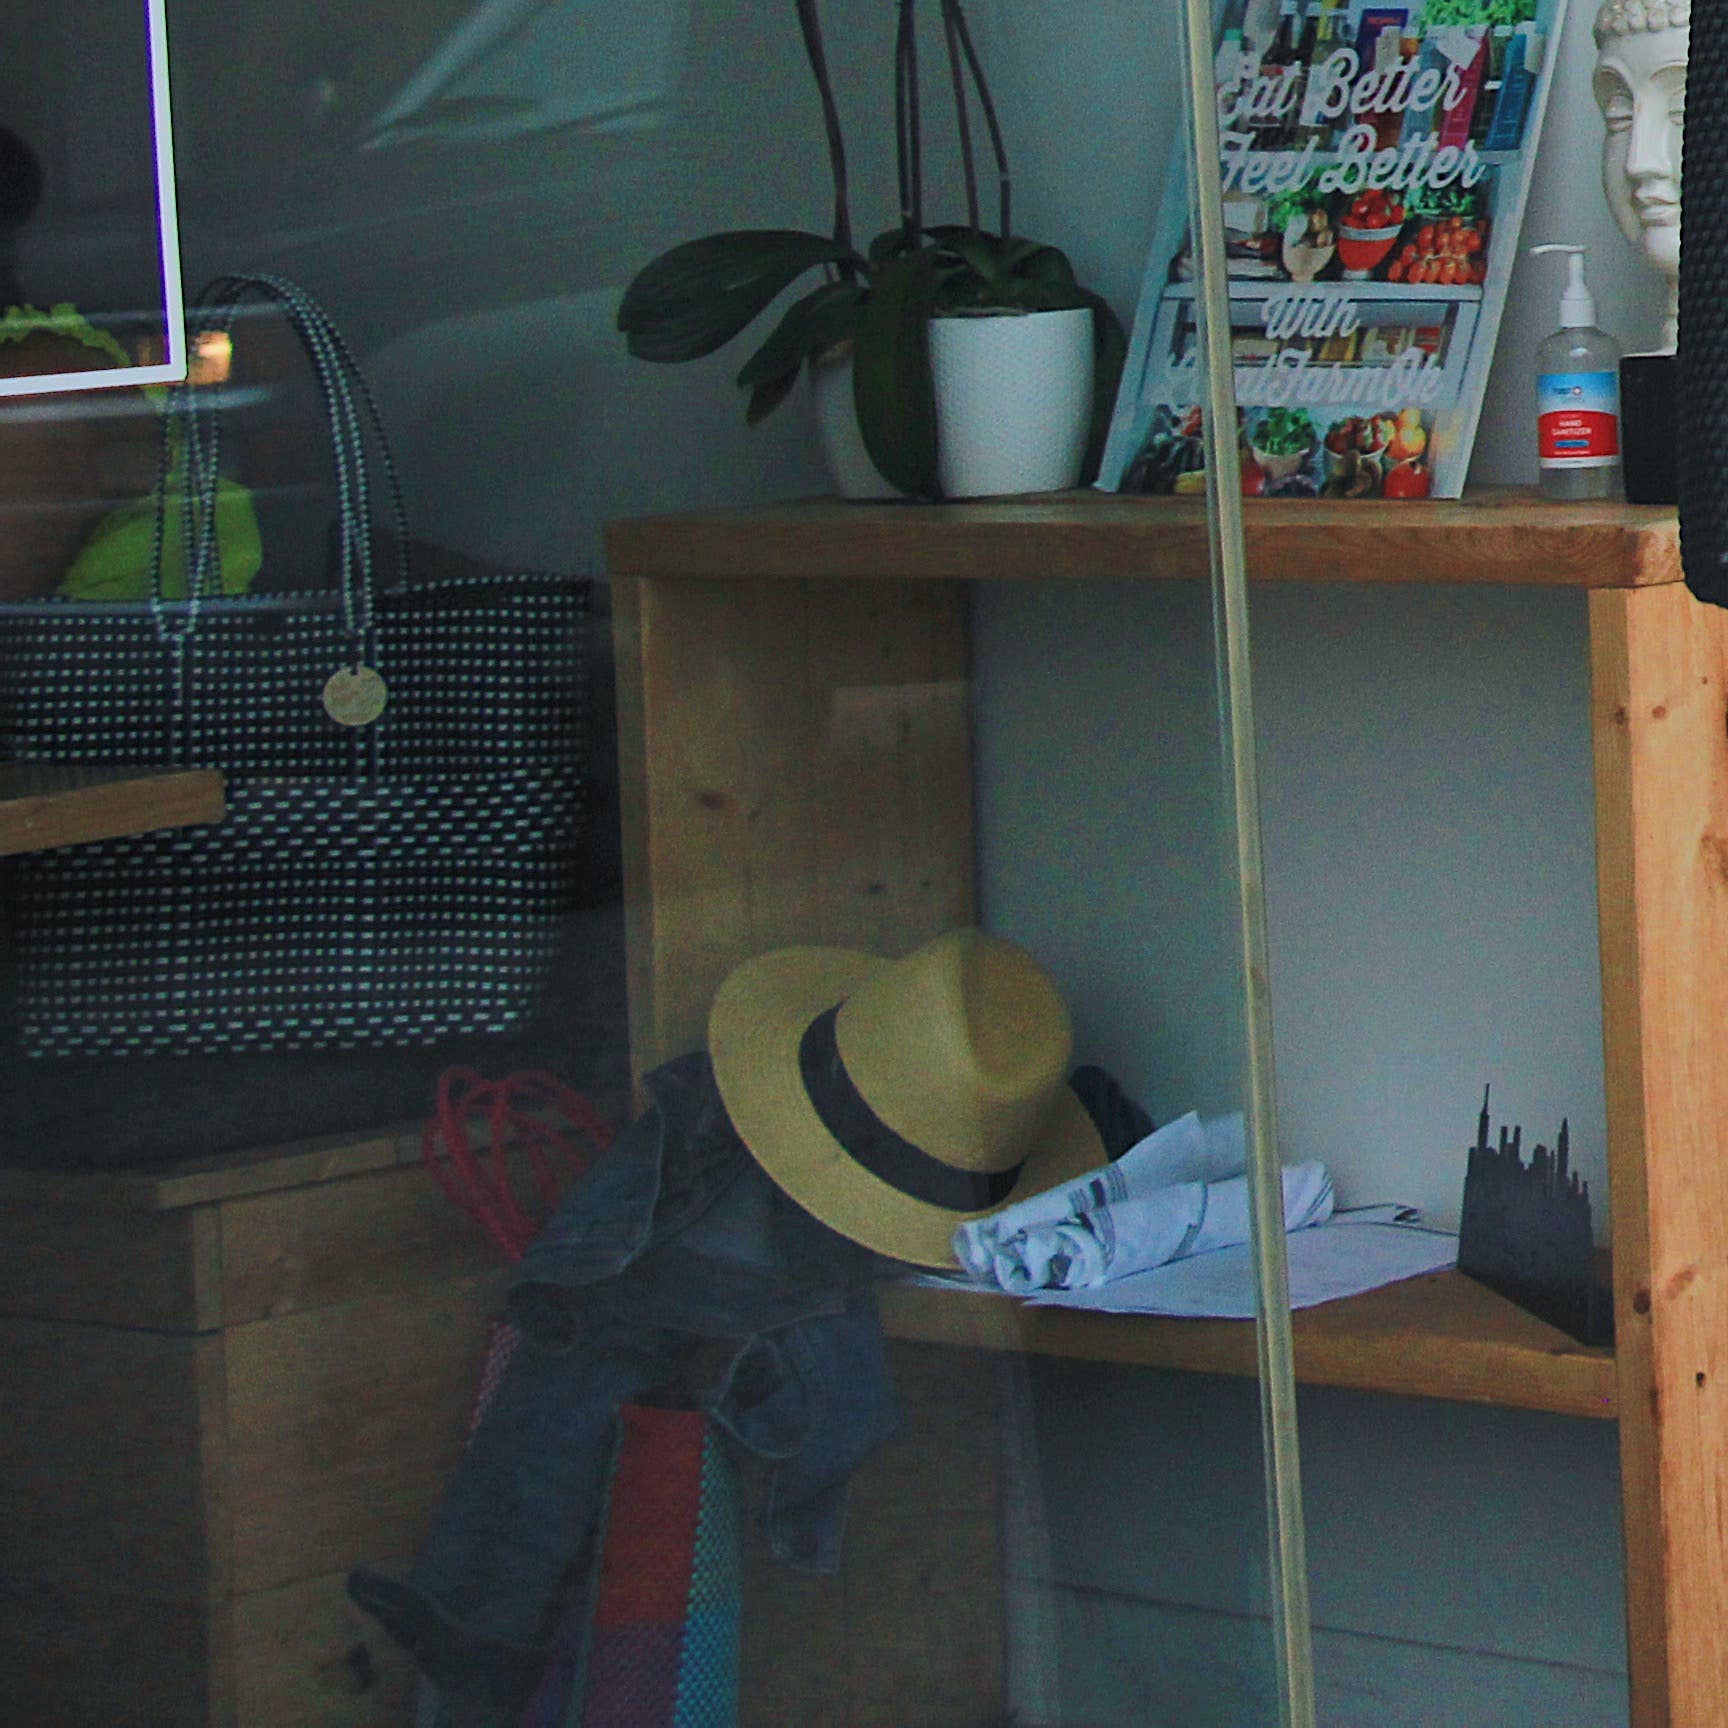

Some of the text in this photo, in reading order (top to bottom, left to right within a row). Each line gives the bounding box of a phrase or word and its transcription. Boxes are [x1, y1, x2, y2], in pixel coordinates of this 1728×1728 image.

[1217, 60, 1301, 123] Eat
[1317, 48, 1467, 119] Better
[1219, 123, 1487, 196] Feel Better
[1260, 293, 1360, 341] With
